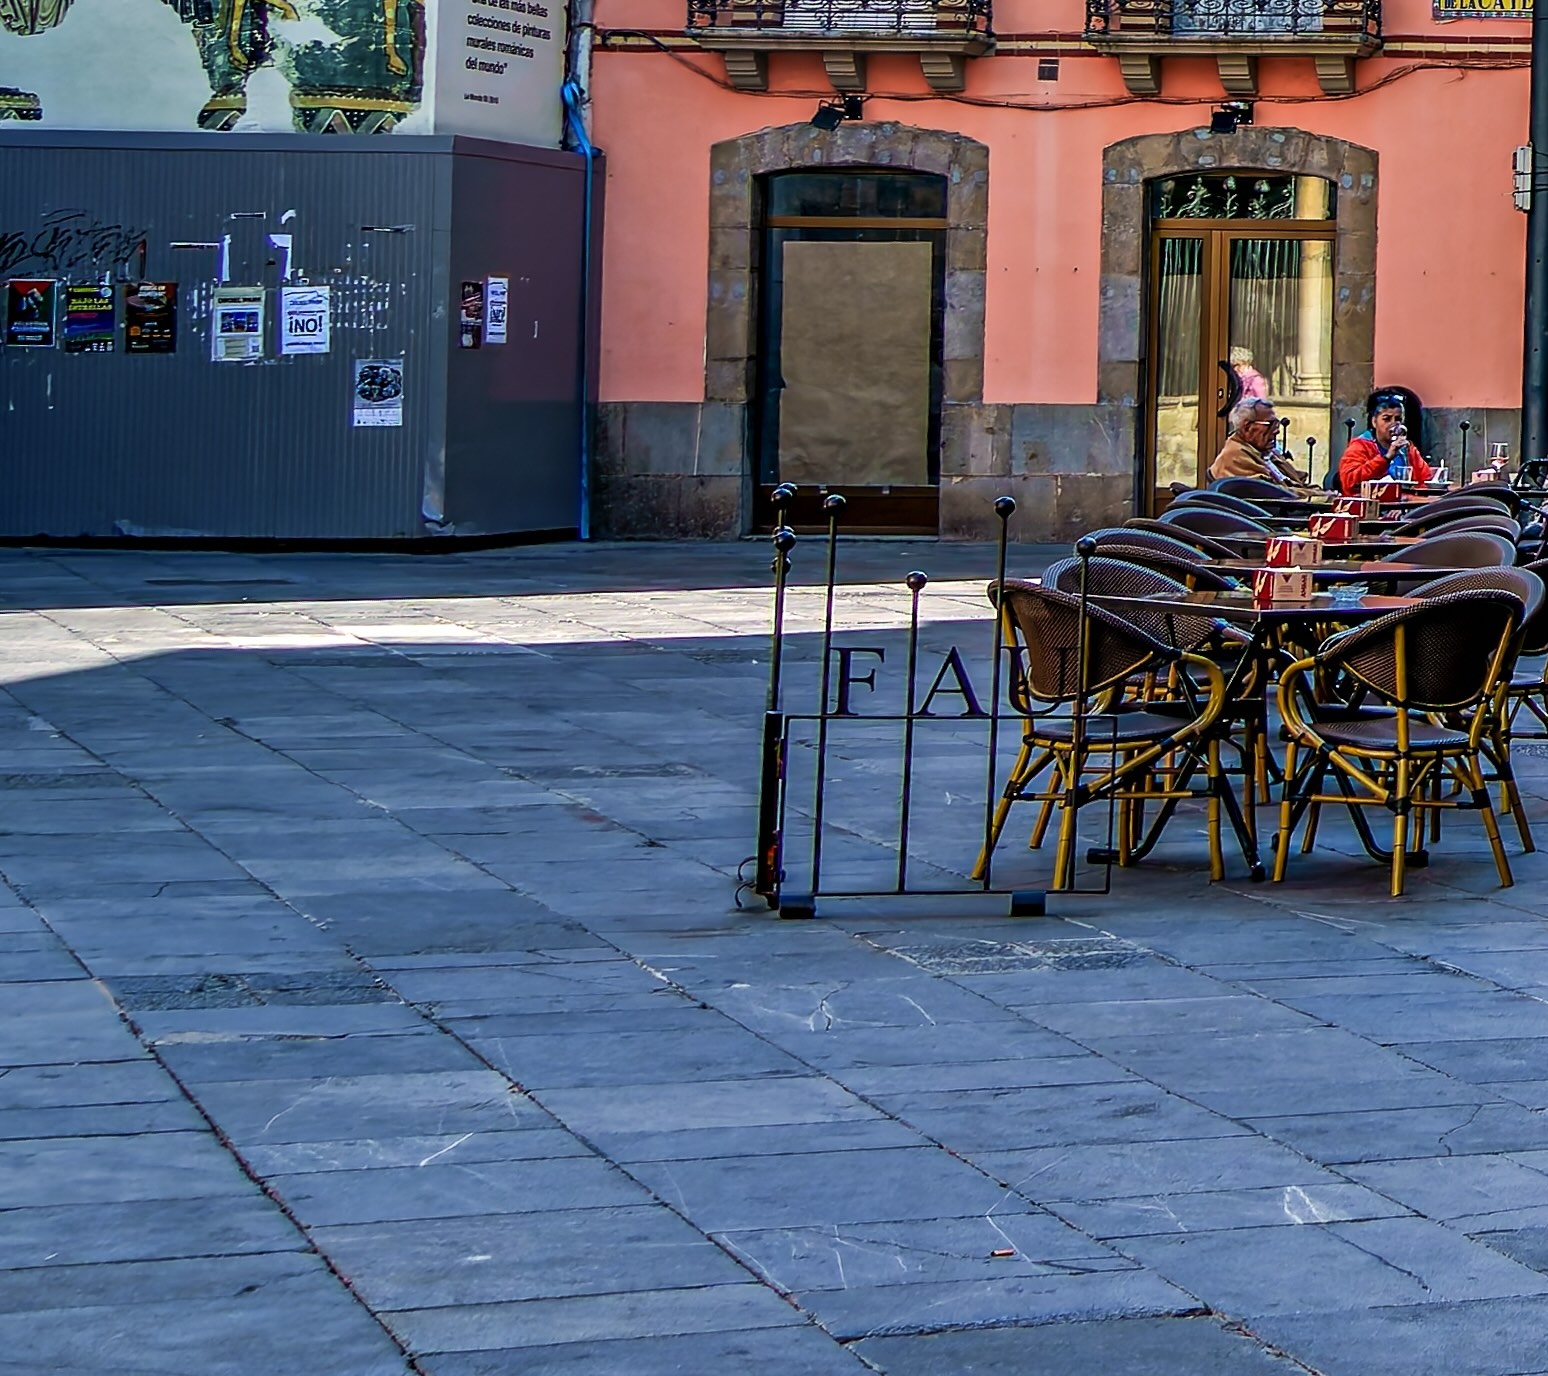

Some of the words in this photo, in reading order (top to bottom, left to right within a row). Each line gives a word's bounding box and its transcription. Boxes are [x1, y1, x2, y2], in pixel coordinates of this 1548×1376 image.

[527, 1, 548, 18] bellas
[468, 13, 510, 33] colecciones
[512, 20, 521, 34] de
[522, 23, 551, 40] pinturas
[466, 36, 496, 52] murales
[465, 56, 478, 71] del
[289, 315, 323, 334] ¡NO!
